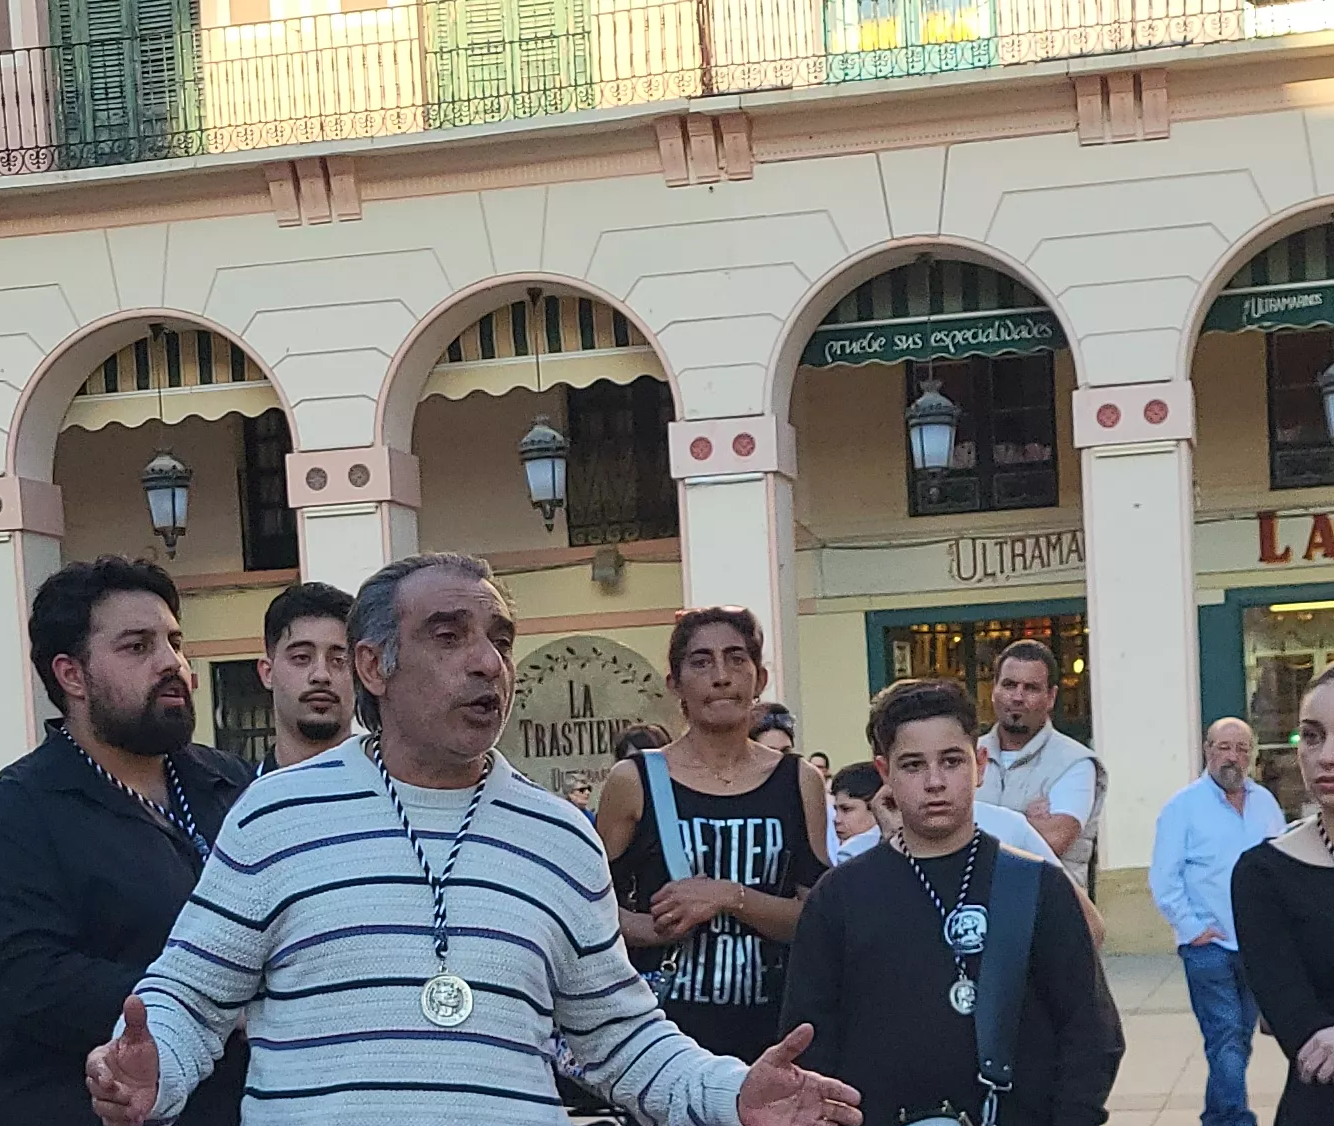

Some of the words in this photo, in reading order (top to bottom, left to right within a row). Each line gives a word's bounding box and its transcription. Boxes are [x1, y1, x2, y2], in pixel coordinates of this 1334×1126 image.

[893, 333, 923, 350] sus
[931, 318, 1053, 353] especialidades
[955, 530, 1085, 581] ULTRAMA
[569, 680, 594, 719] LA
[519, 719, 631, 758] TRASTIEN
[678, 817, 784, 886] BETTER
[671, 933, 769, 1006] ALONE
